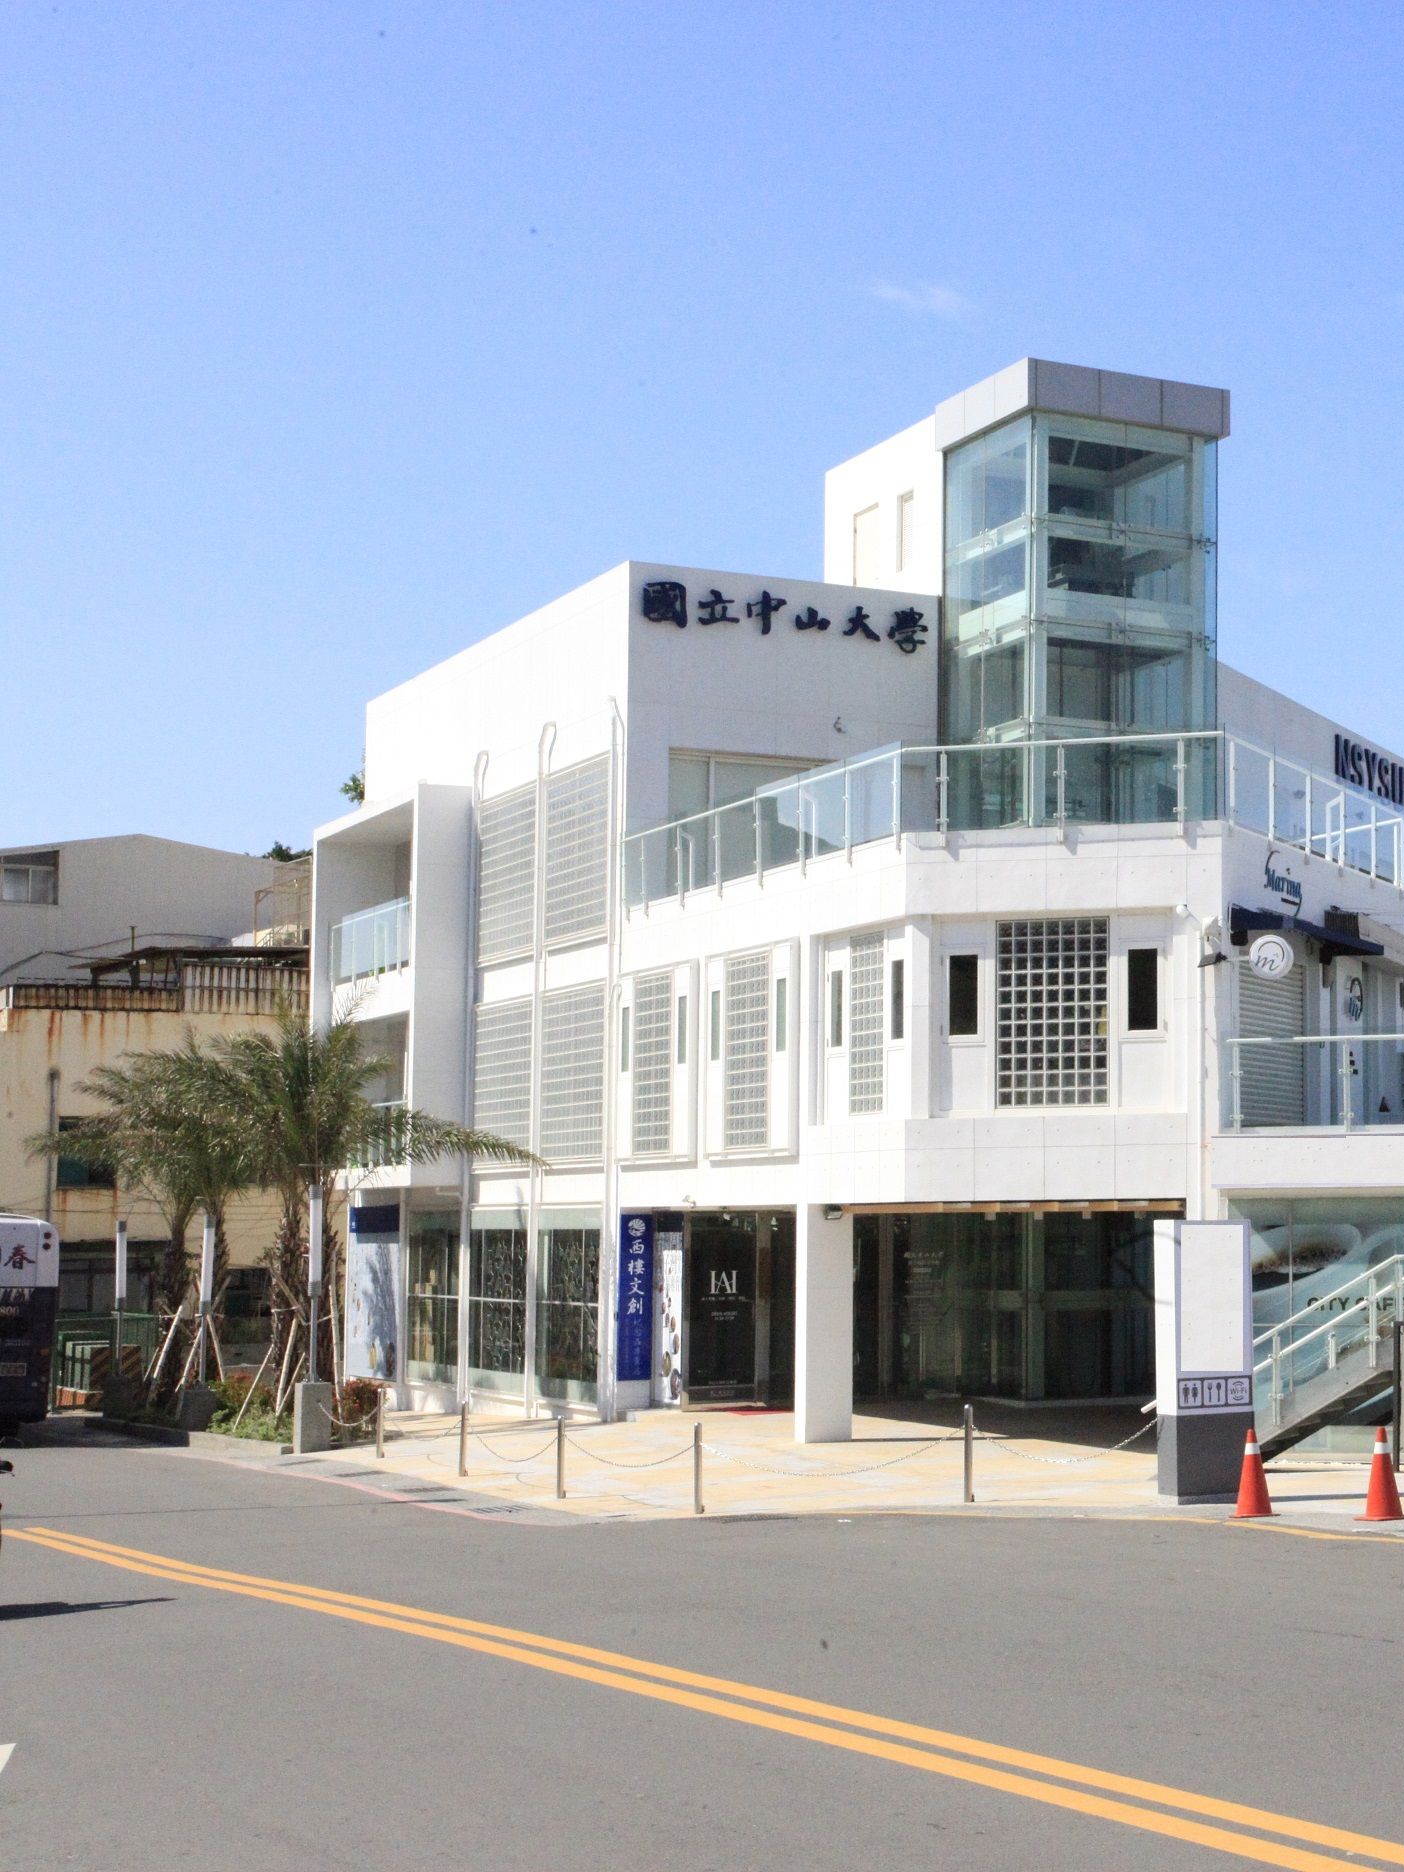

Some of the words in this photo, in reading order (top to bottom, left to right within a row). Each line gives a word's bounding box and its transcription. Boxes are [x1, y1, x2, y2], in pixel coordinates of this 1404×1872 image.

[642, 580, 929, 654] 國立中山大學
[1334, 733, 1404, 806] NSYSU
[0, 1243, 36, 1270] 春
[627, 1239, 645, 1316] 西樓文創
